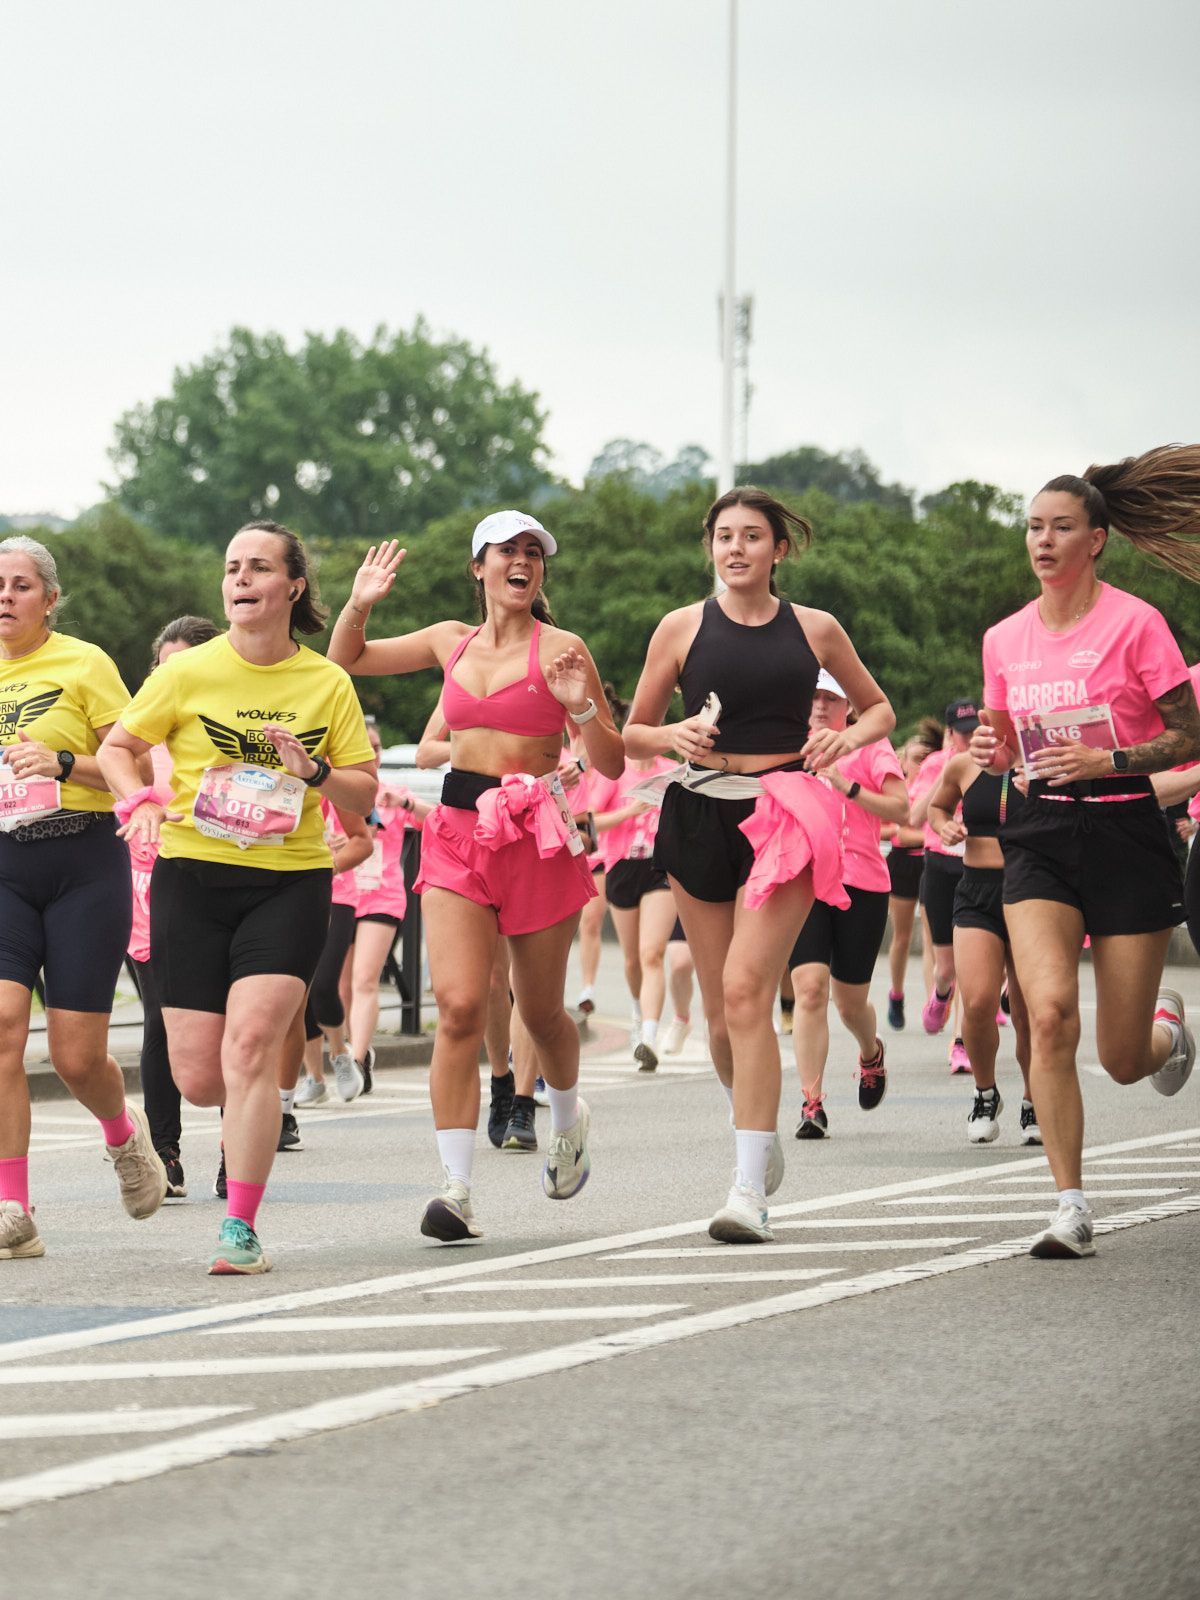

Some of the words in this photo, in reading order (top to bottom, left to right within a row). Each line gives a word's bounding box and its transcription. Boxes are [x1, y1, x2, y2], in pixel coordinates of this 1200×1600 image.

[1009, 679, 1089, 712] CARRERA
[236, 709, 298, 723] WOLVES
[249, 732, 269, 743] BO
[1045, 725, 1082, 743] 016
[257, 744, 274, 753] TO
[247, 753, 282, 764] RUN
[4, 801, 17, 809] 622
[226, 799, 266, 822] 016
[235, 819, 250, 828] 613
